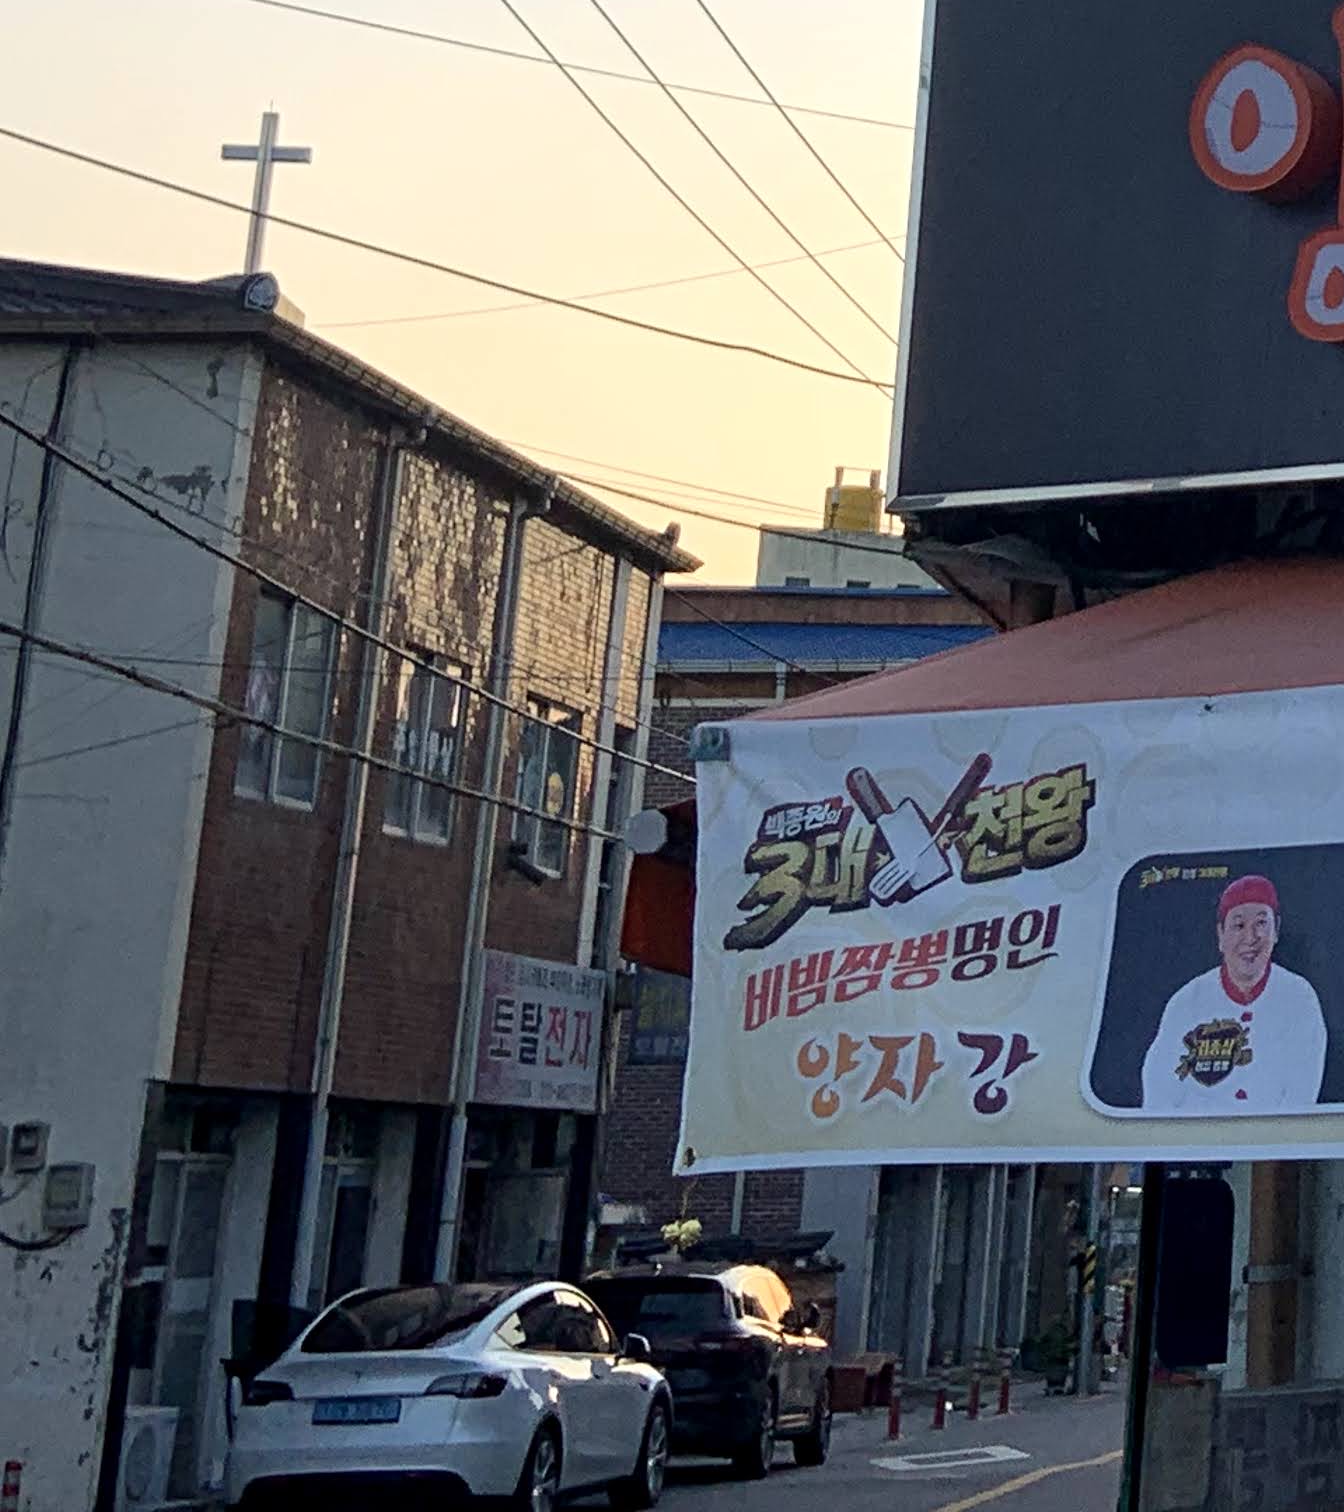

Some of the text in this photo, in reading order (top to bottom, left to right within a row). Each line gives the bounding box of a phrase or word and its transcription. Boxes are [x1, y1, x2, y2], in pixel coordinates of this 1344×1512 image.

[764, 802, 842, 839] 백종원의
[489, 997, 592, 1071] 토탈전자
[797, 1030, 1038, 1117] 양자강
